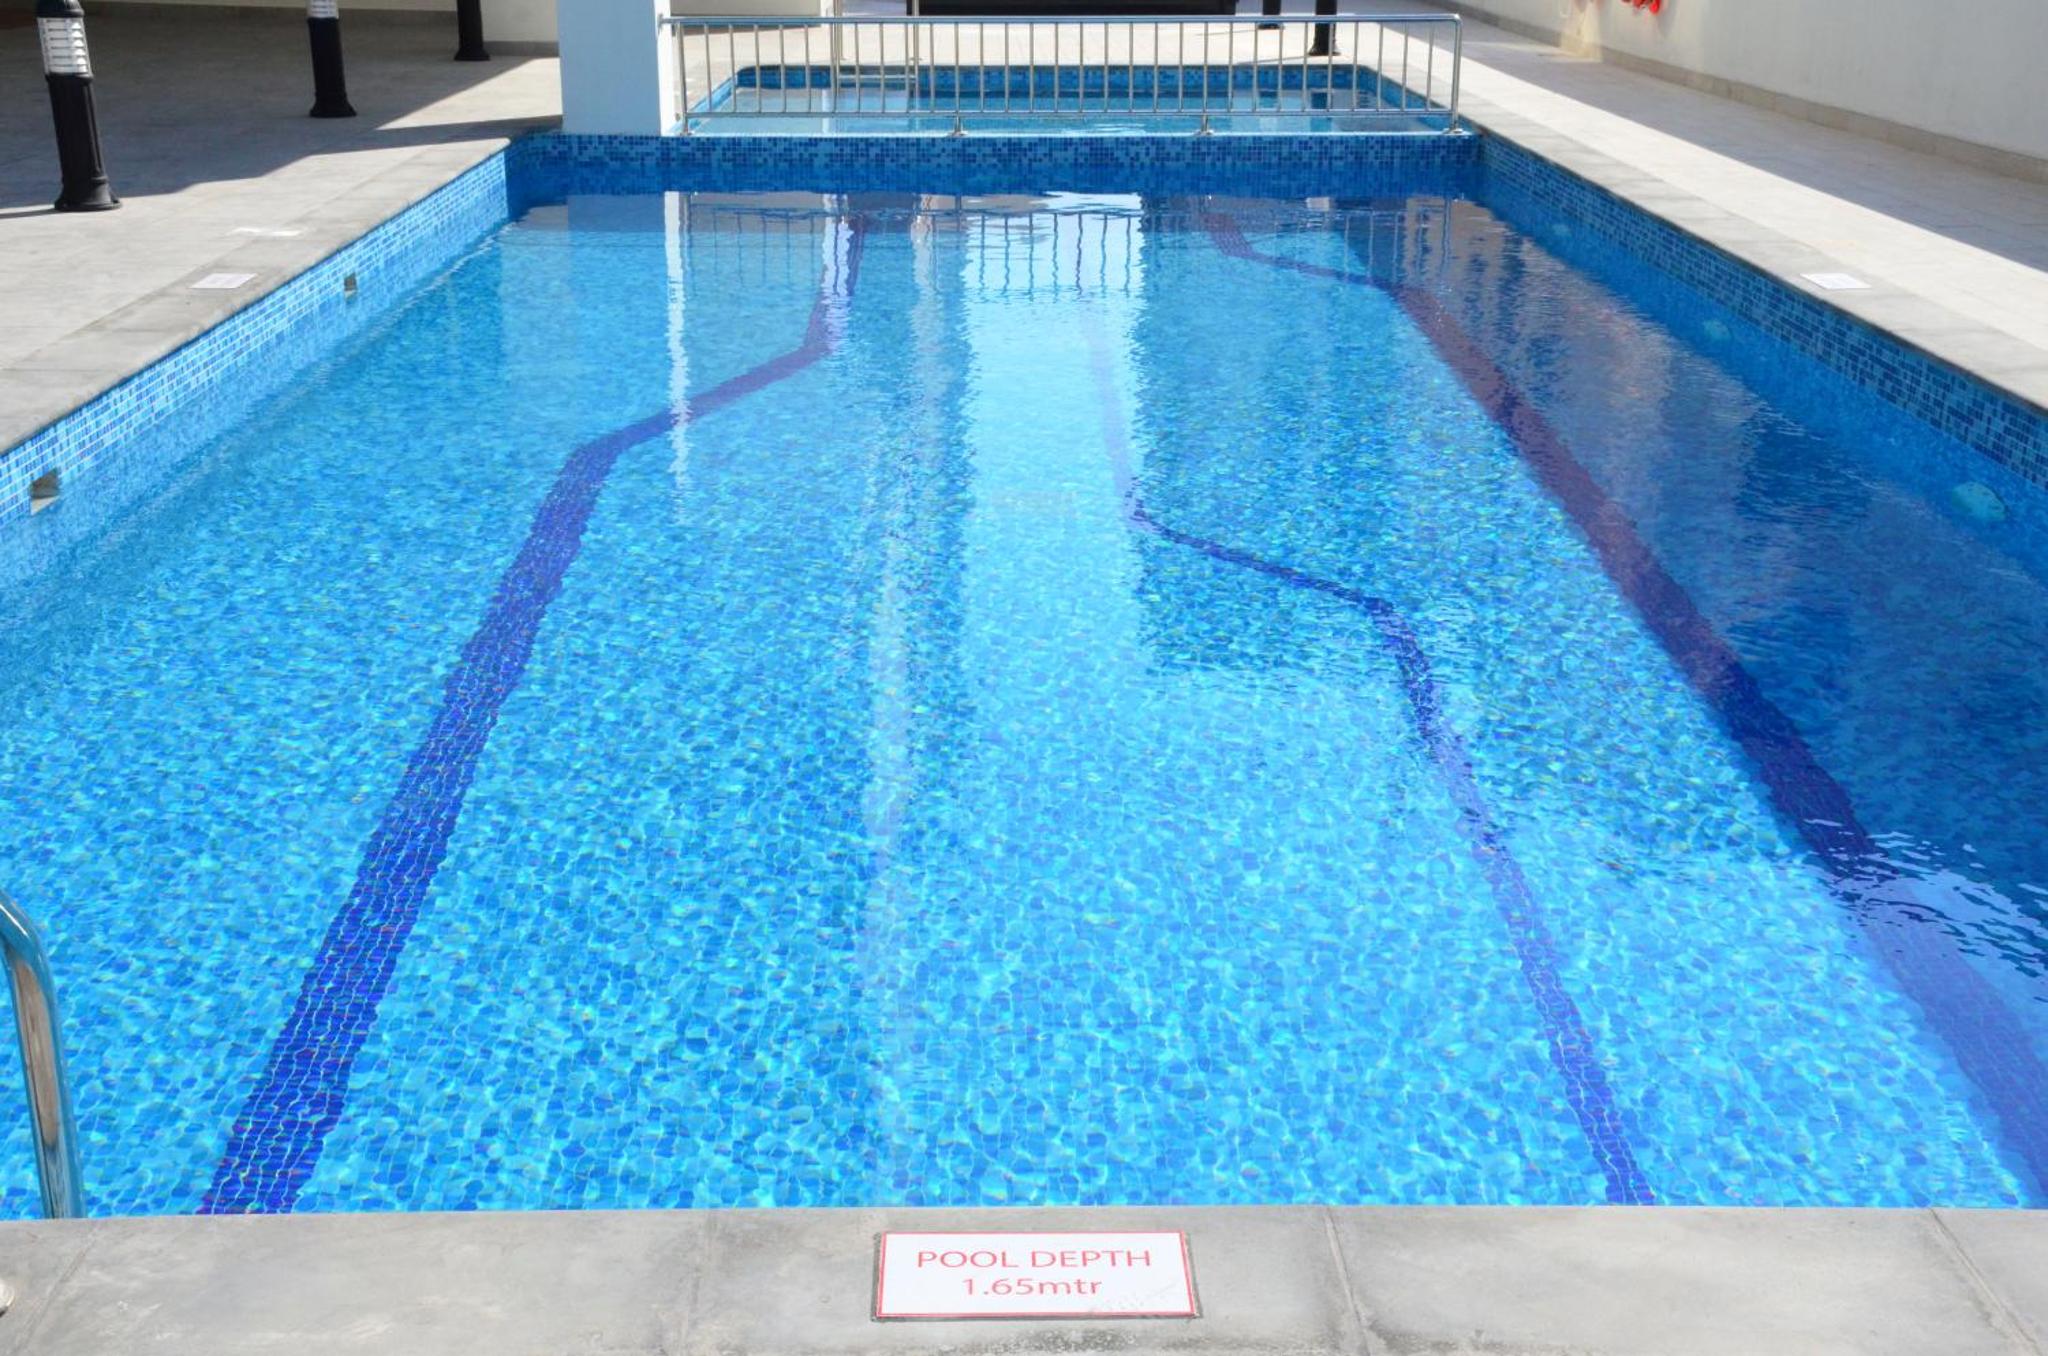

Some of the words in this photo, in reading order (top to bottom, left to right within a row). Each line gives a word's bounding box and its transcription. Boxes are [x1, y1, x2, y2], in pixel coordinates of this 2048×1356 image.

[917, 1250, 1019, 1268] POOL
[1030, 1250, 1151, 1268] DEPTH
[961, 1278, 1102, 1296] 1.65mtr
